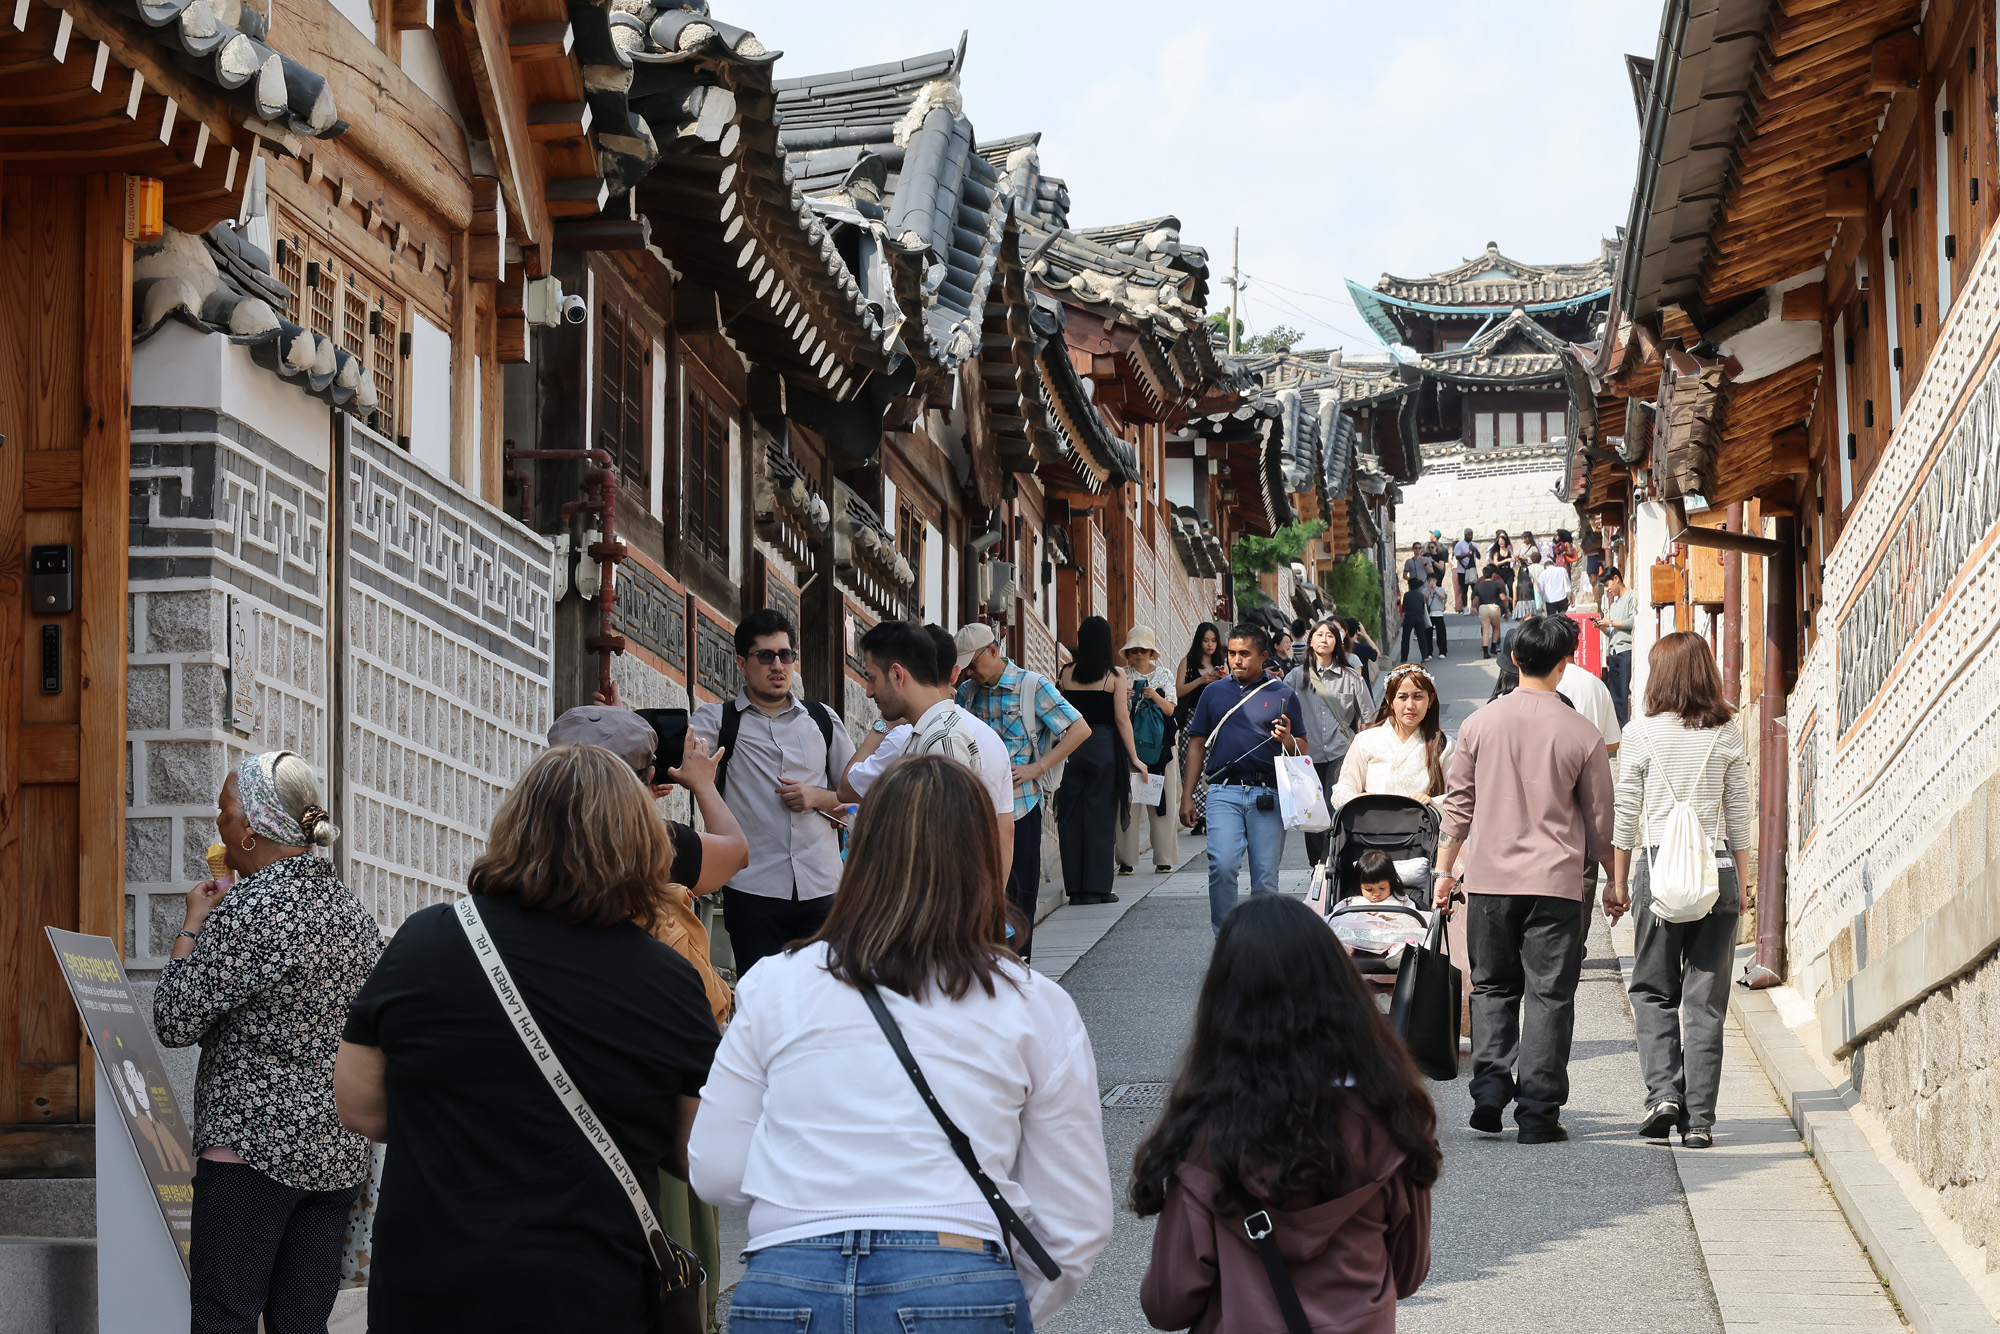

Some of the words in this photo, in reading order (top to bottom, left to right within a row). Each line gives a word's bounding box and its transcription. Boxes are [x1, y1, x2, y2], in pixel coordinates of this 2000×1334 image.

[236, 610, 246, 660] 39
[476, 933, 492, 956] LRL
[490, 965, 523, 1015] LAUREN
[518, 1016, 550, 1062] RALPH
[553, 1070, 572, 1095] LRL
[575, 1104, 611, 1153] LAUREN
[609, 1153, 638, 1196] RALPH
[642, 1204, 654, 1229] LRL
